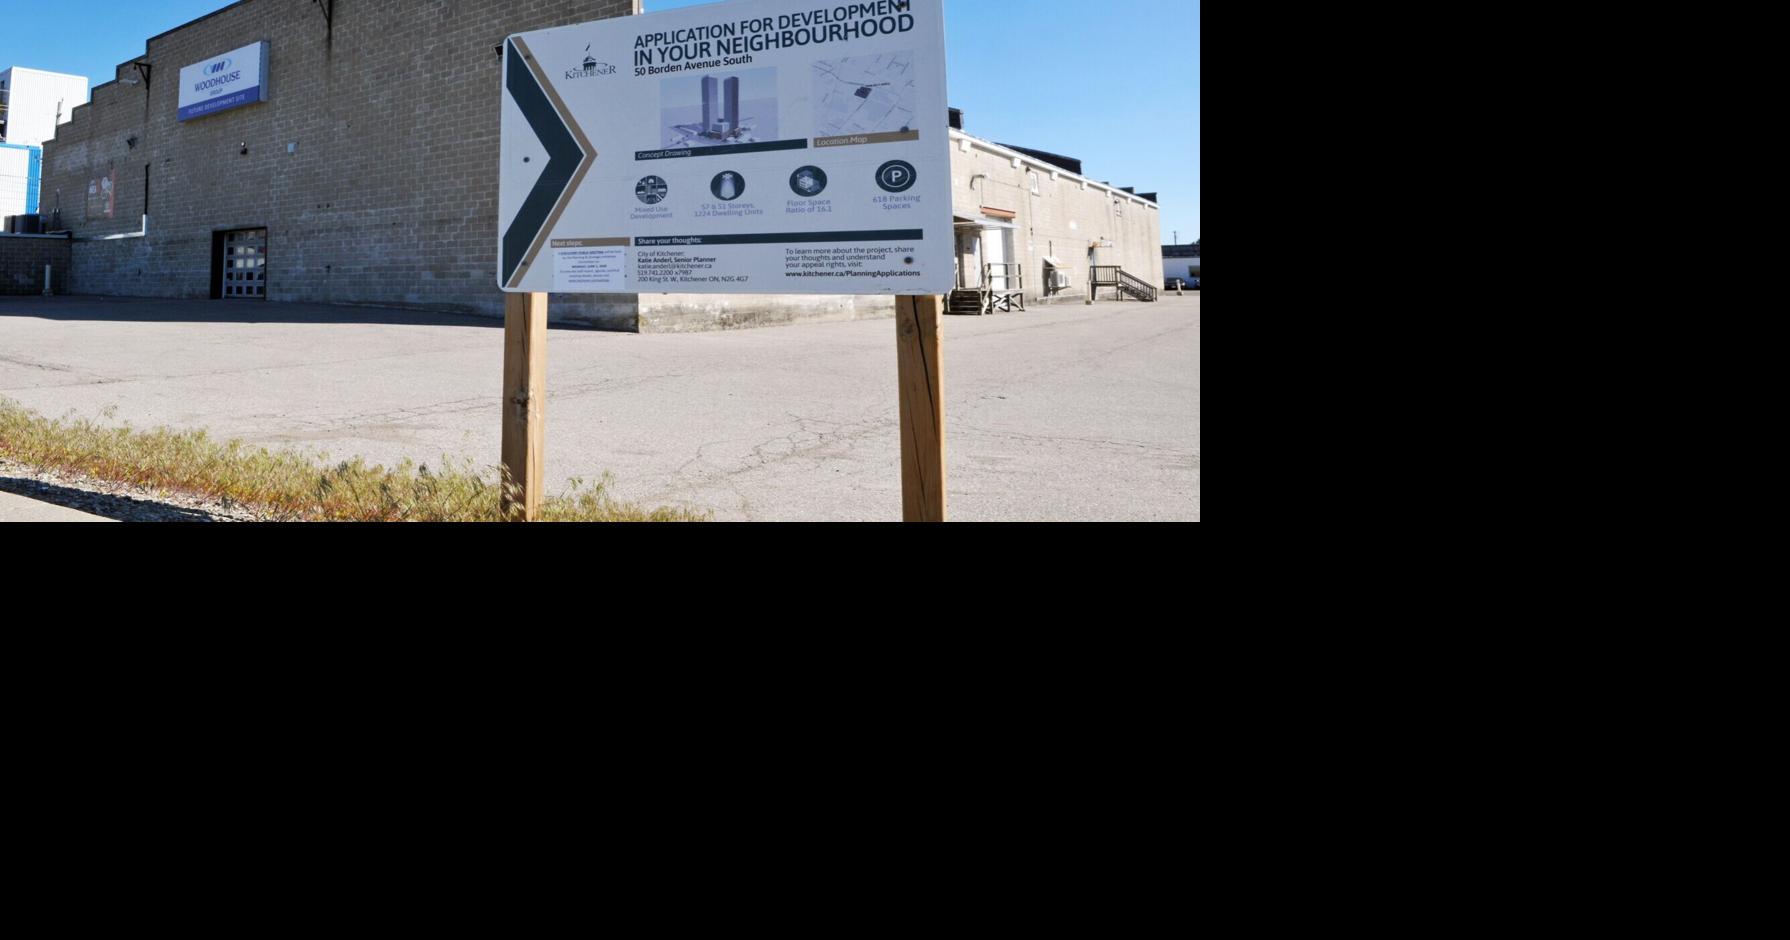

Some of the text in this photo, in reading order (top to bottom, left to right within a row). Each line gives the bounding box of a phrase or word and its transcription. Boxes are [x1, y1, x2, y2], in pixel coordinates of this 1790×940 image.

[633, 22, 736, 49] APPLICATION
[740, 17, 773, 35] FOR
[634, 13, 914, 67] IN YOUR NEIGHBOURHOOD
[634, 53, 753, 76] 50 Borden Avenue South
[565, 64, 617, 80] KITCHENER
[194, 70, 241, 92] WOODHOUSE
[816, 136, 868, 146] Location Map
[637, 149, 692, 160] Concept Drawing
[891, 170, 902, 182] P
[807, 198, 831, 207] Space
[889, 195, 921, 203] Parking
[630, 212, 672, 220] Development
[712, 208, 743, 217] Dwelling
[672, 236, 702, 245] thoughts:
[866, 246, 894, 255] project,
[801, 254, 831, 262] thoughts
[846, 253, 886, 261] understand
[801, 261, 825, 269] appeal
[825, 261, 846, 269] rights,
[784, 269, 921, 278] www.kitchener.ca/PlanningApplications
